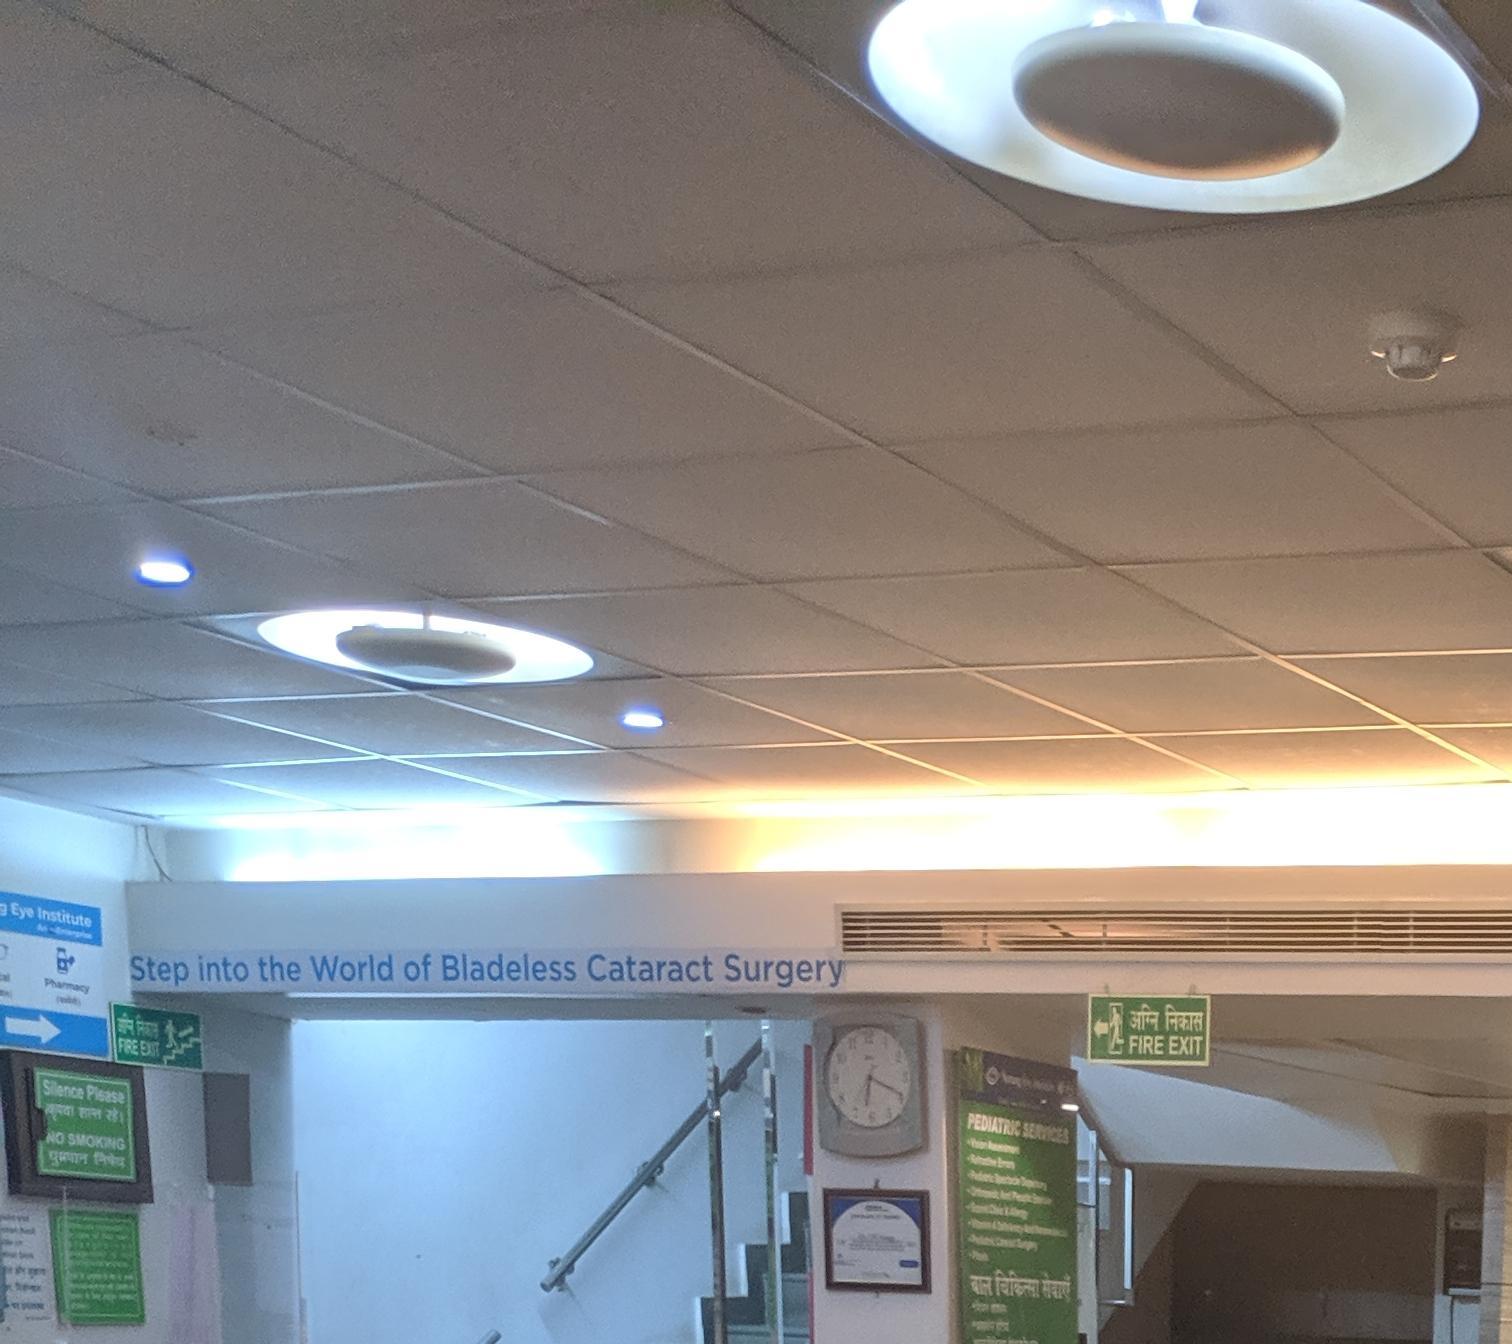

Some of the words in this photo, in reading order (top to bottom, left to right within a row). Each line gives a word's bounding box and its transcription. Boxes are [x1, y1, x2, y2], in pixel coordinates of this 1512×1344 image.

[10, 902, 34, 920] Eye
[37, 906, 93, 928] Institute
[130, 955, 190, 987] Step
[198, 955, 250, 983] into
[258, 955, 302, 983] the
[309, 954, 395, 983] World
[403, 954, 433, 983] of
[441, 953, 578, 983] Bladeless
[586, 954, 714, 983] Cataract
[723, 954, 847, 988] Surgery
[44, 977, 90, 996] Pharmacy
[1165, 1003, 1204, 1032] निकास
[117, 1037, 139, 1056] FIRE
[140, 1040, 160, 1057] EXIT
[1128, 1035, 1165, 1055] FIRE
[1168, 1035, 1204, 1056] EXIT
[42, 1079, 84, 1100] Silence
[86, 1084, 125, 1105] Please
[46, 1131, 65, 1145] NO
[67, 1133, 126, 1151] SMOKING
[967, 1112, 1020, 1137] PEDIATRIC
[1022, 1121, 1069, 1145] SERVICES
